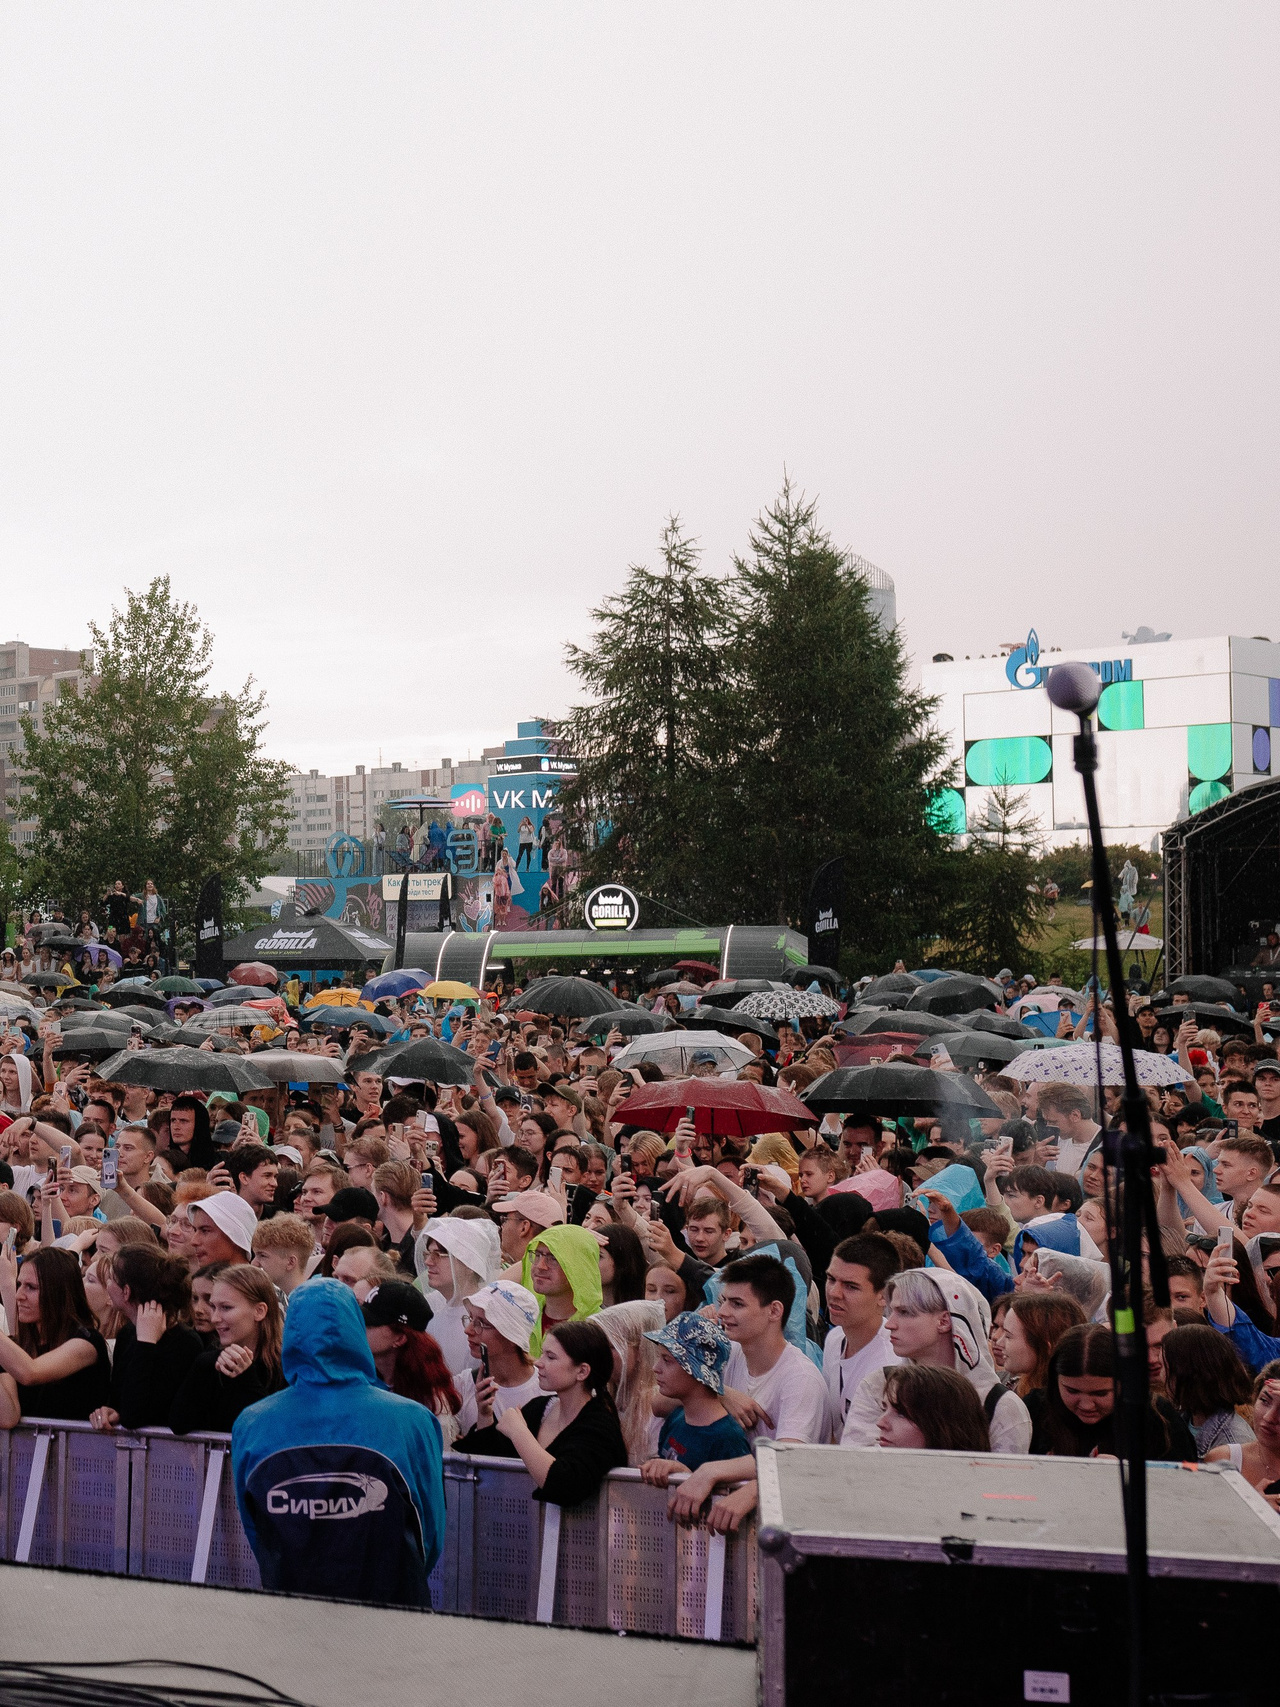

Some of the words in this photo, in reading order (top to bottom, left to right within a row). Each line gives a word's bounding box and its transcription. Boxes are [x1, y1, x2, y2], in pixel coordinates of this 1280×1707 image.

[493, 790, 525, 809] VK
[387, 878, 410, 887] Как
[412, 879, 422, 887] ты
[423, 878, 444, 888] трек
[592, 905, 631, 919] GORILLA
[815, 917, 839, 933] GORILLA
[254, 938, 318, 950] GORILLA
